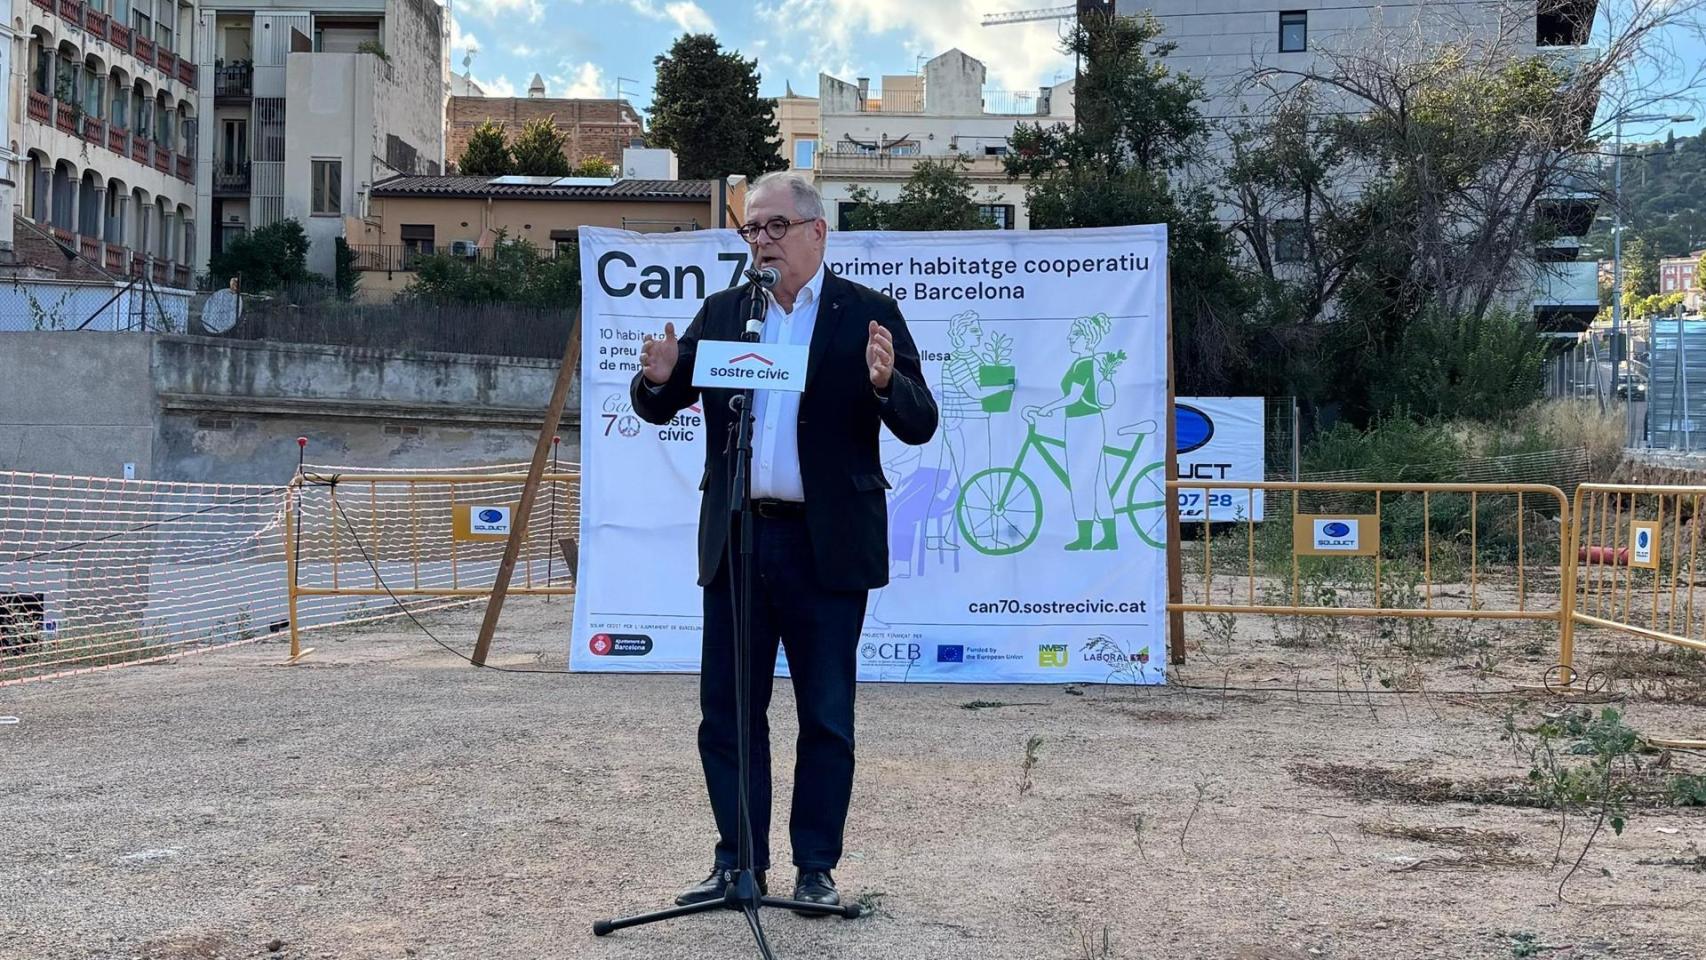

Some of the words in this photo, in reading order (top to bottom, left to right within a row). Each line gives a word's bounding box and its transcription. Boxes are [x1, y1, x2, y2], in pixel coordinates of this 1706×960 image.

[830, 257, 903, 275] primer
[910, 256, 1017, 278] habitatge
[1024, 253, 1149, 277] cooperatiu
[597, 250, 705, 300] Can
[718, 252, 748, 289] 7
[881, 282, 907, 300] de
[914, 282, 1025, 300] Barcelona
[599, 328, 613, 340] 10
[599, 346, 607, 355] a
[611, 346, 637, 358] preu
[921, 350, 951, 361] llesa
[599, 359, 616, 370] de
[710, 367, 754, 378] sostre
[757, 367, 790, 380] cívic
[665, 414, 701, 427] stre
[658, 427, 694, 442] cívic
[1177, 463, 1232, 479] UCT
[968, 599, 1147, 614] can70.sostrecivic.cat
[879, 643, 921, 660] CEB
[1039, 644, 1068, 652] INVEST
[1039, 651, 1068, 667] EU
